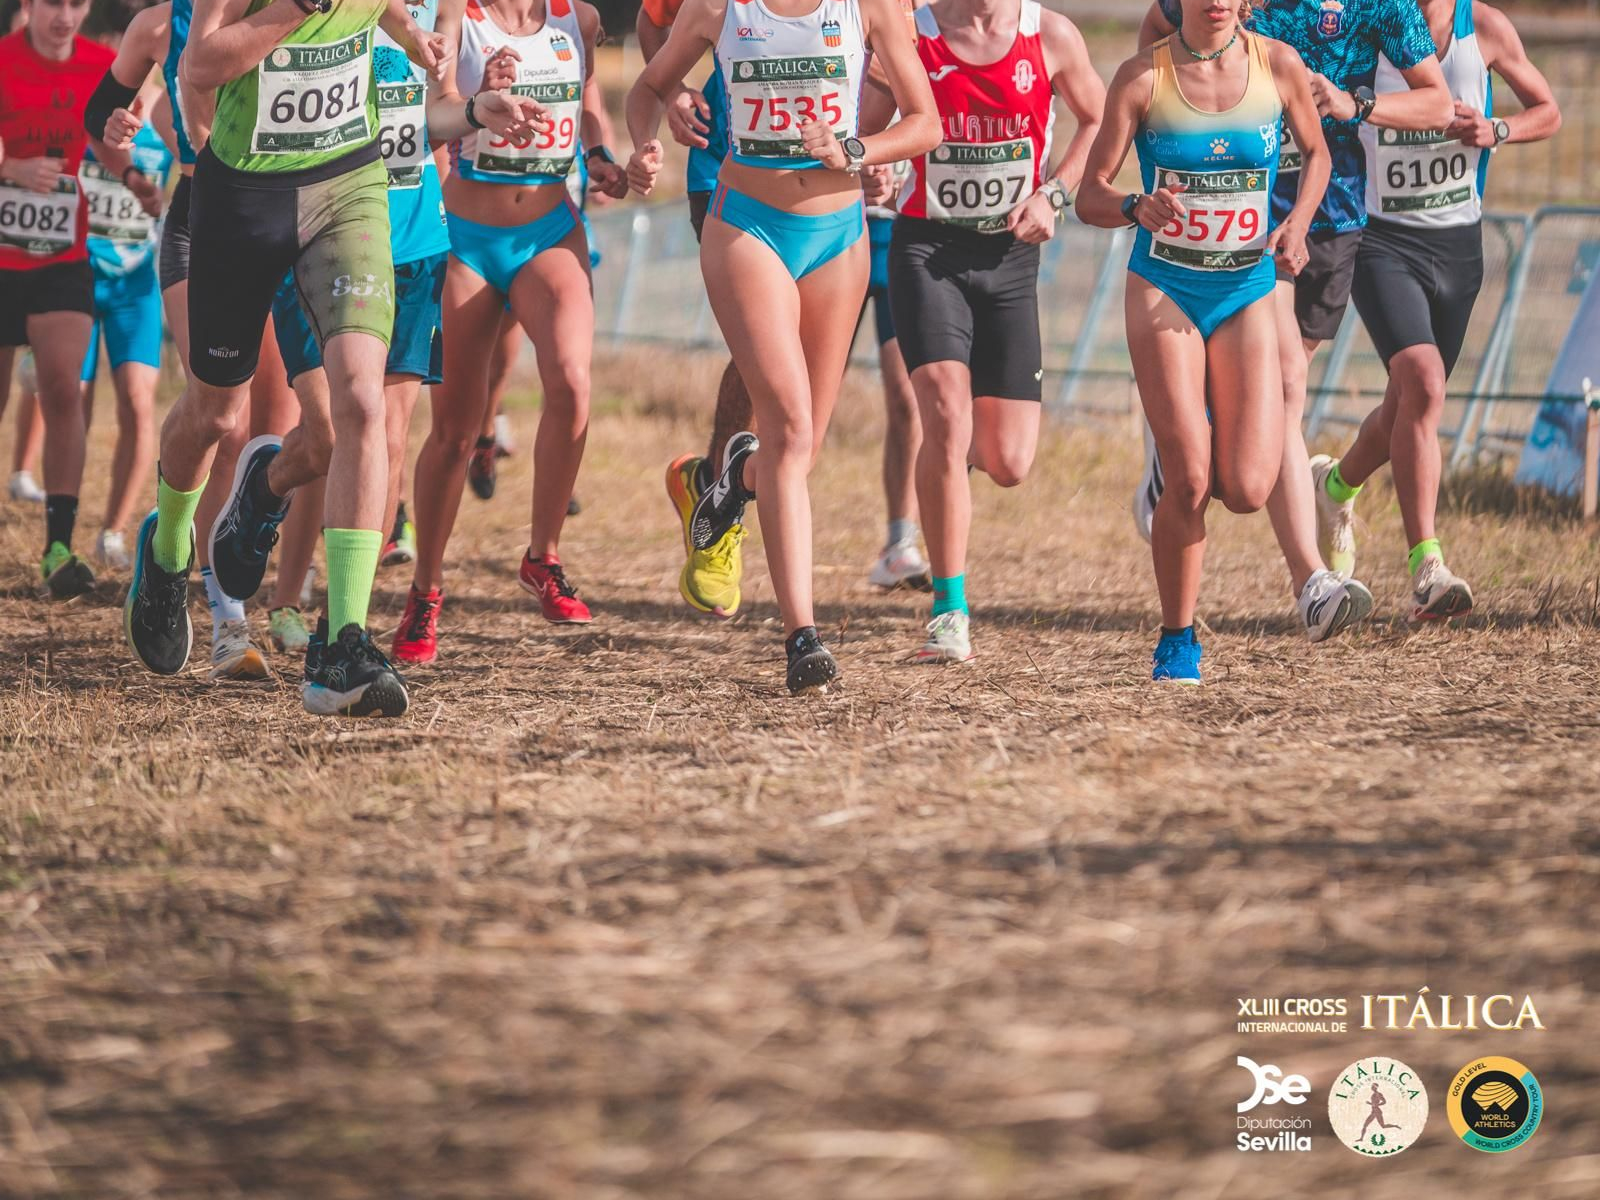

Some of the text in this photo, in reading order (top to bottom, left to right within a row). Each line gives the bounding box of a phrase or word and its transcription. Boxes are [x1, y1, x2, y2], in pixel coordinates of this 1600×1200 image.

[300, 43, 351, 64] ITÁLICA
[761, 59, 818, 75] ITÁLICA
[270, 75, 360, 124] 6081
[743, 92, 842, 132] 7535
[941, 112, 1031, 143] URTIUS
[957, 145, 1006, 159] ITÁLICA
[1186, 174, 1240, 188] ITÁLICA
[1387, 153, 1467, 189] 6100
[938, 175, 1026, 209] 6097
[0, 201, 69, 232] 6082
